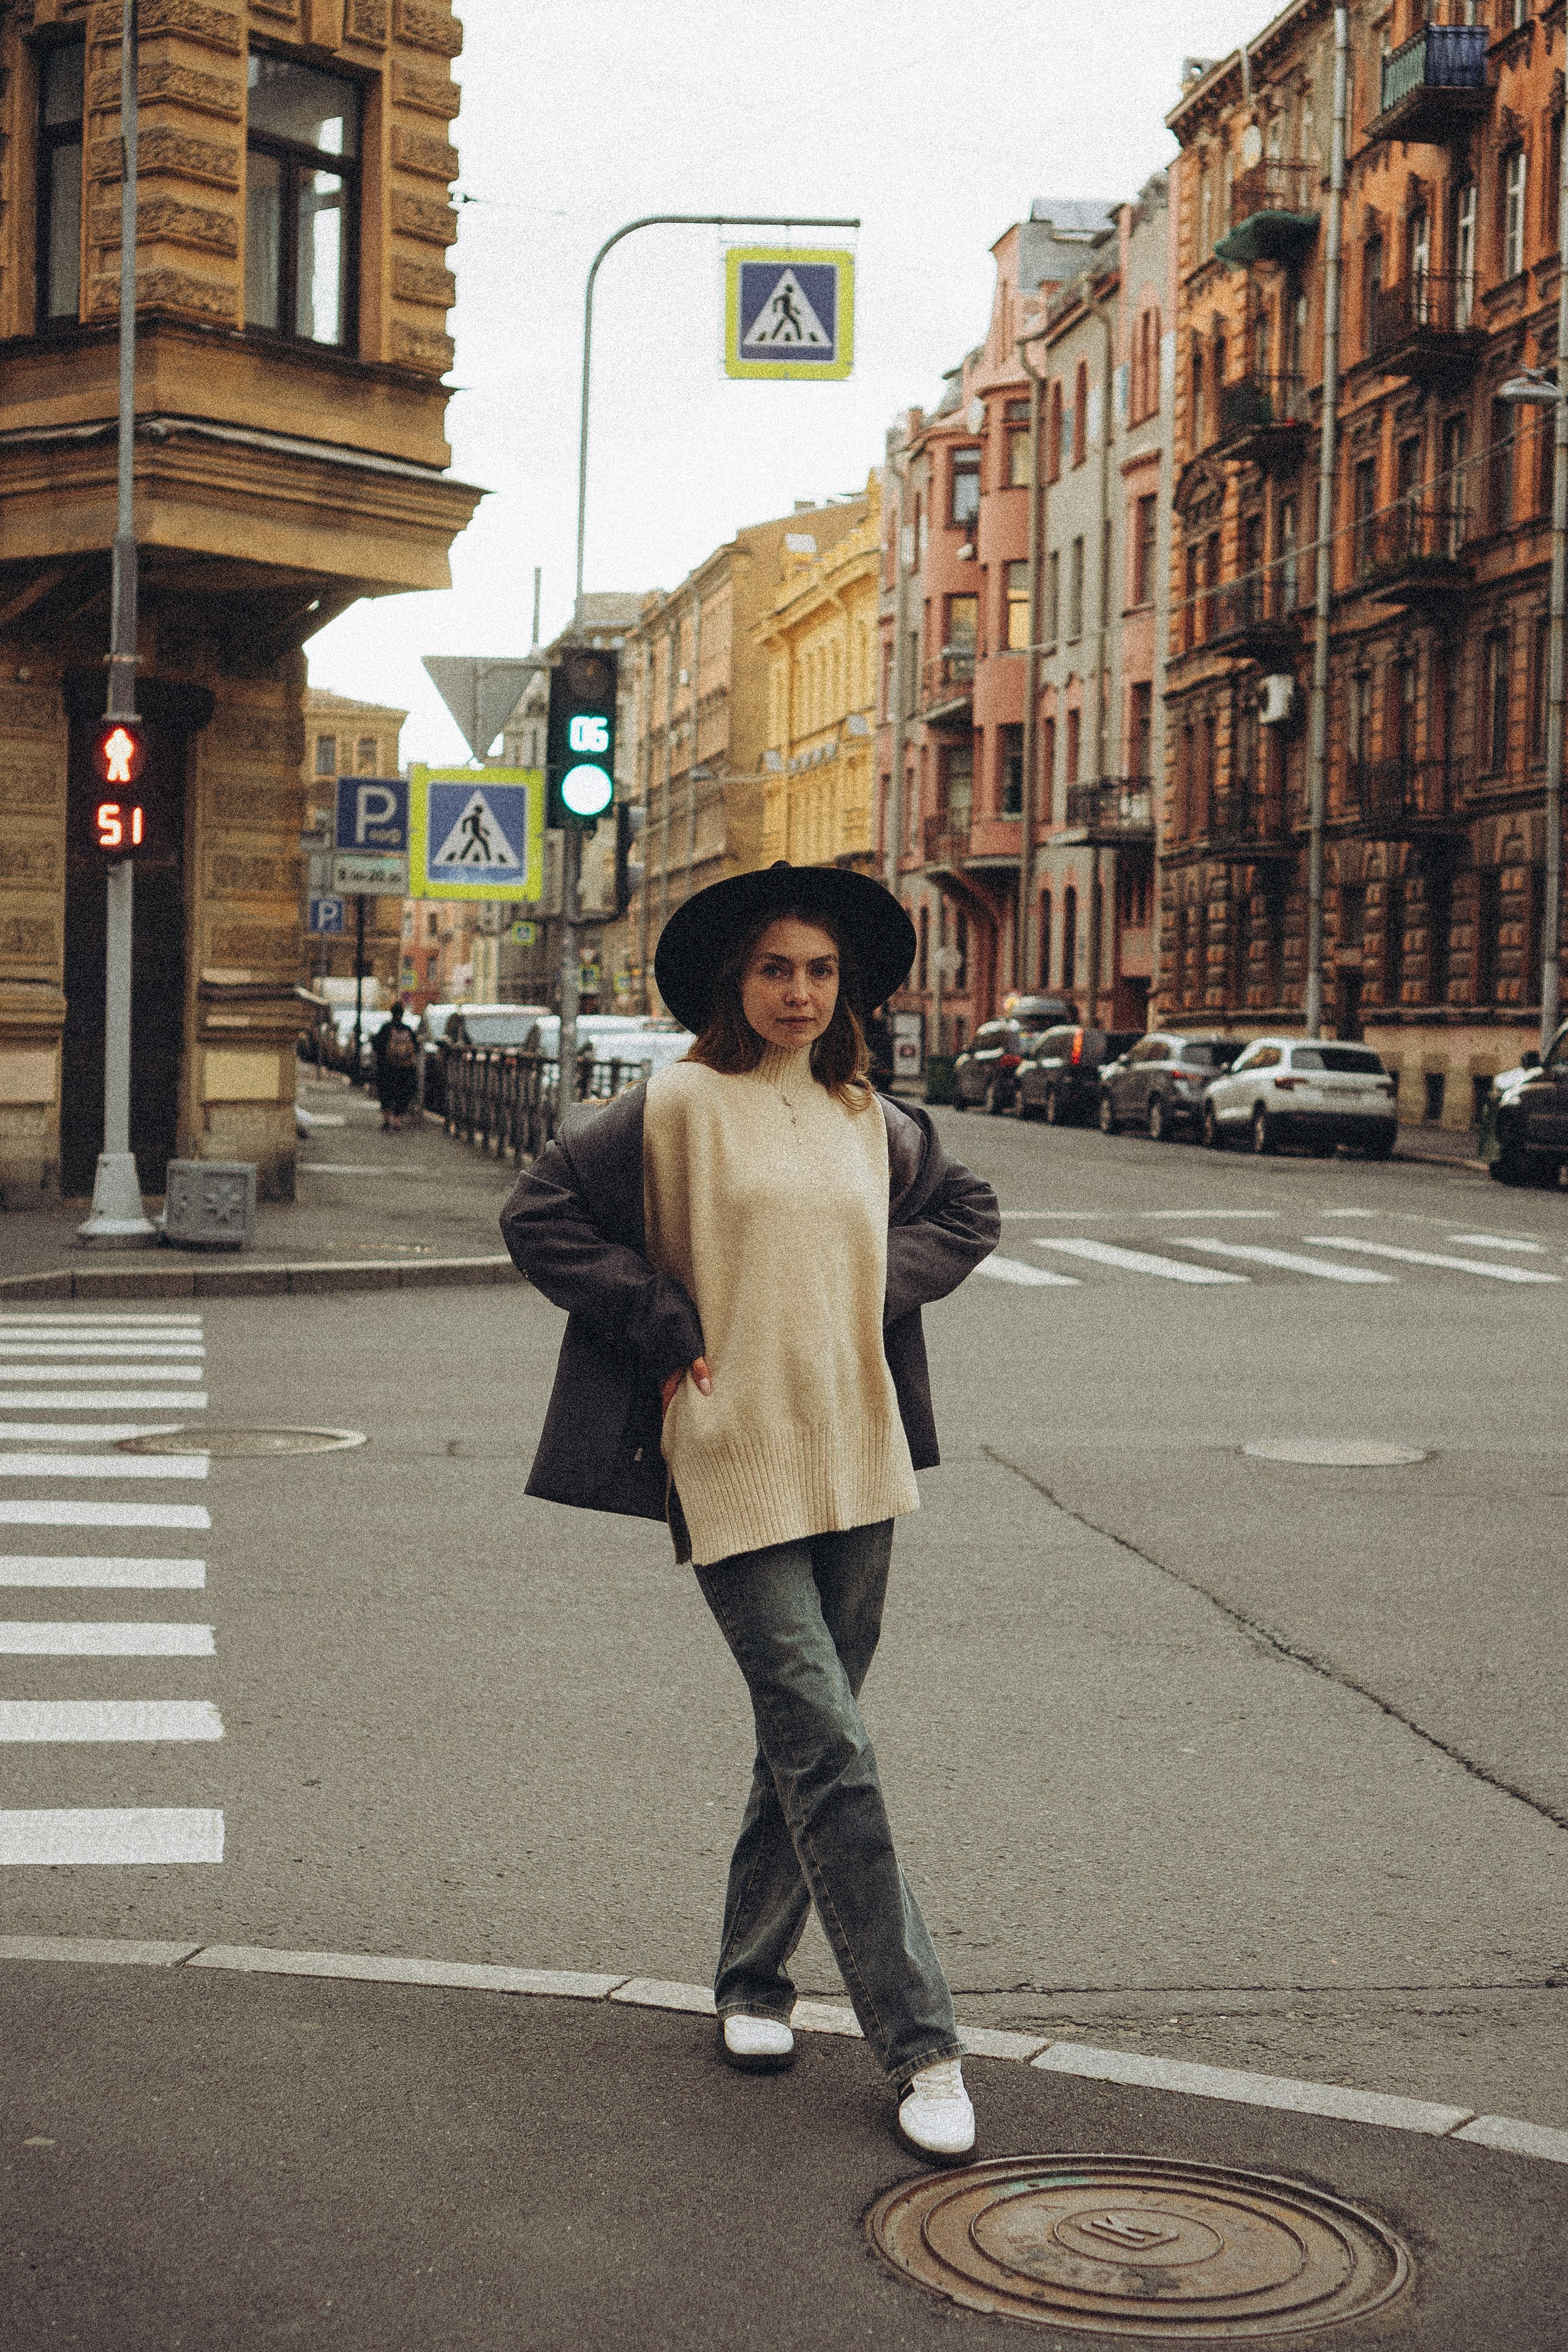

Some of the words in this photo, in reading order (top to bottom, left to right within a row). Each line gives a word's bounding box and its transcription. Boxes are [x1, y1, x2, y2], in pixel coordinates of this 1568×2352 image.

[569, 715, 609, 753] 06
[97, 803, 143, 846] 51
[356, 786, 396, 843] P
[318, 900, 338, 929] P
